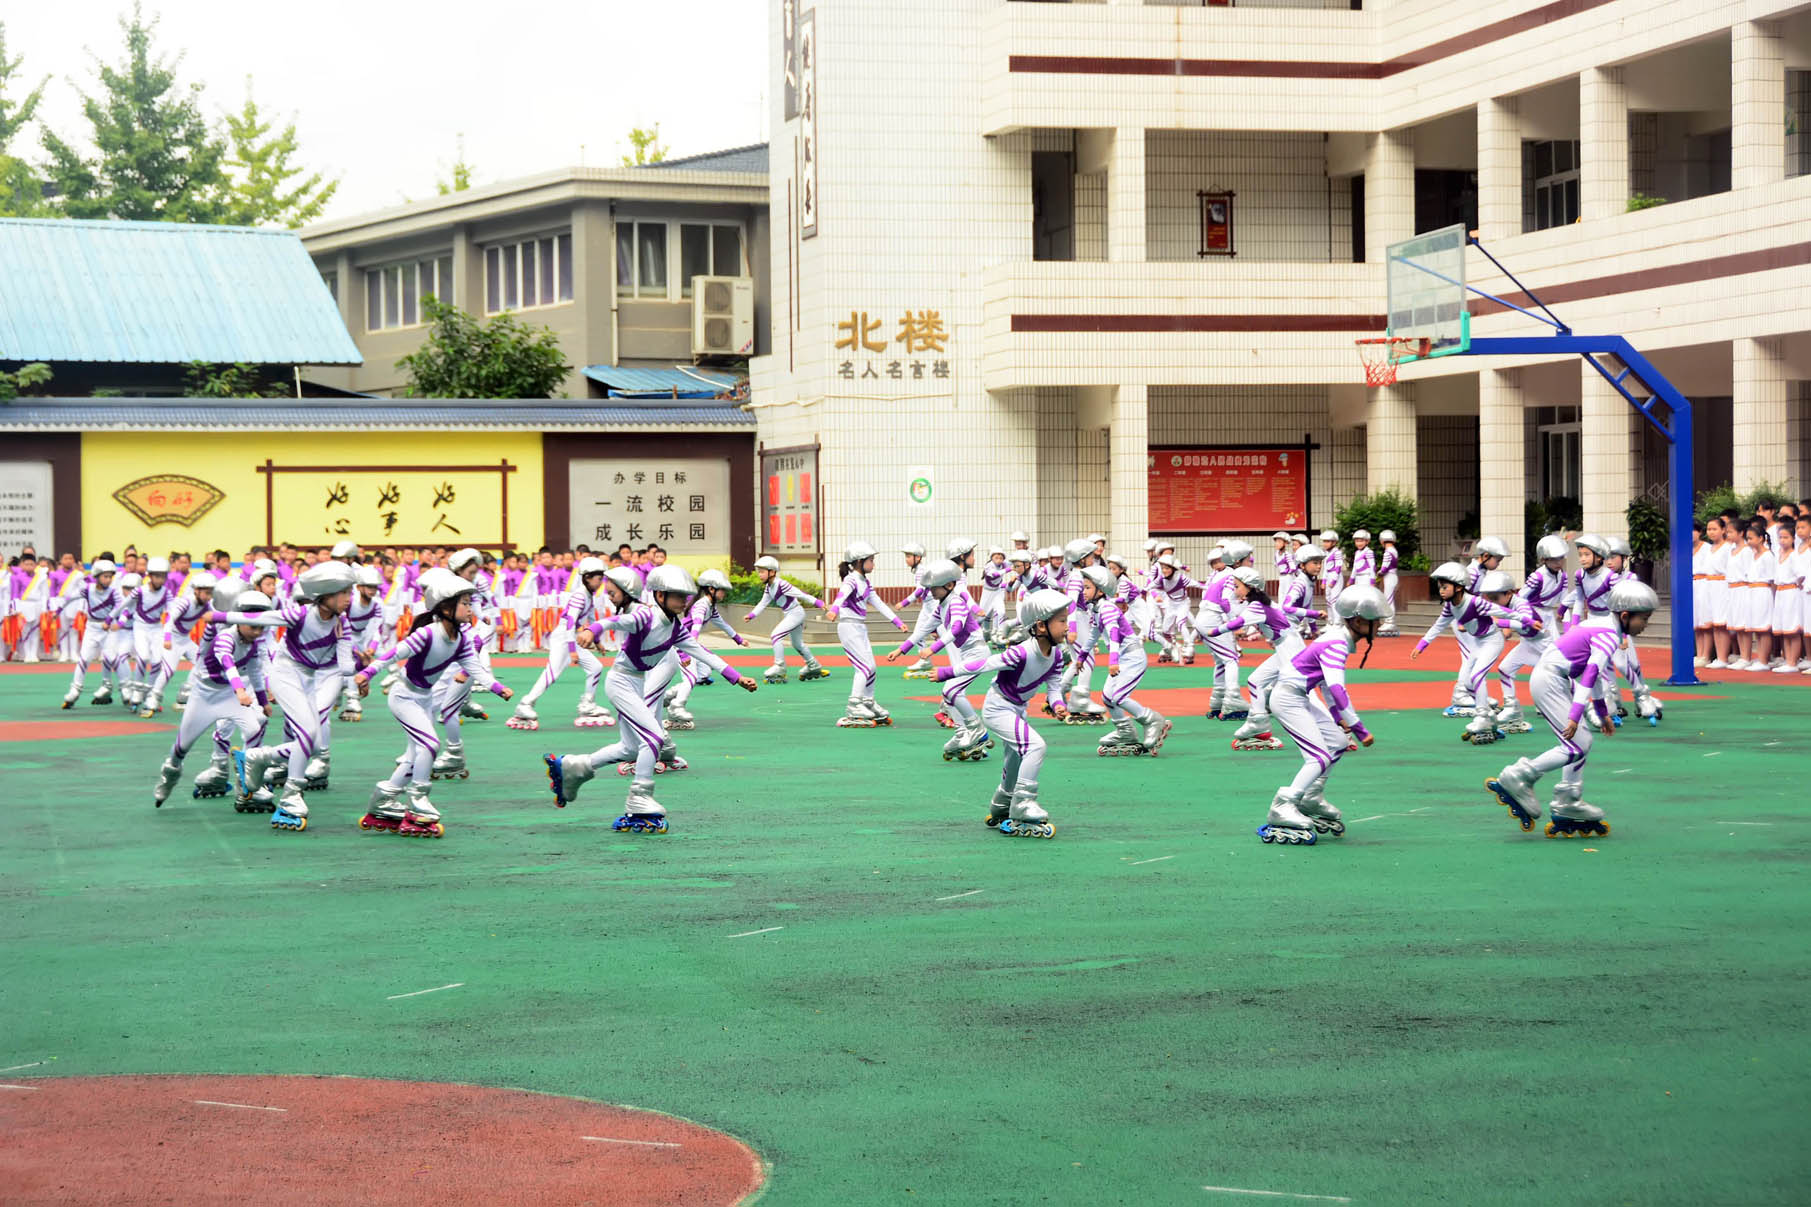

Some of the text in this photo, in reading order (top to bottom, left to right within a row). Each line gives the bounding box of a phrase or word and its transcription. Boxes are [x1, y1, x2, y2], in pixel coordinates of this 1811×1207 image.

[834, 308, 949, 354] 北楼
[838, 360, 950, 379] 名人名言楼
[614, 472, 687, 484] 办学目标
[595, 494, 705, 512] 一流校园
[595, 523, 705, 541] 成长乐园
